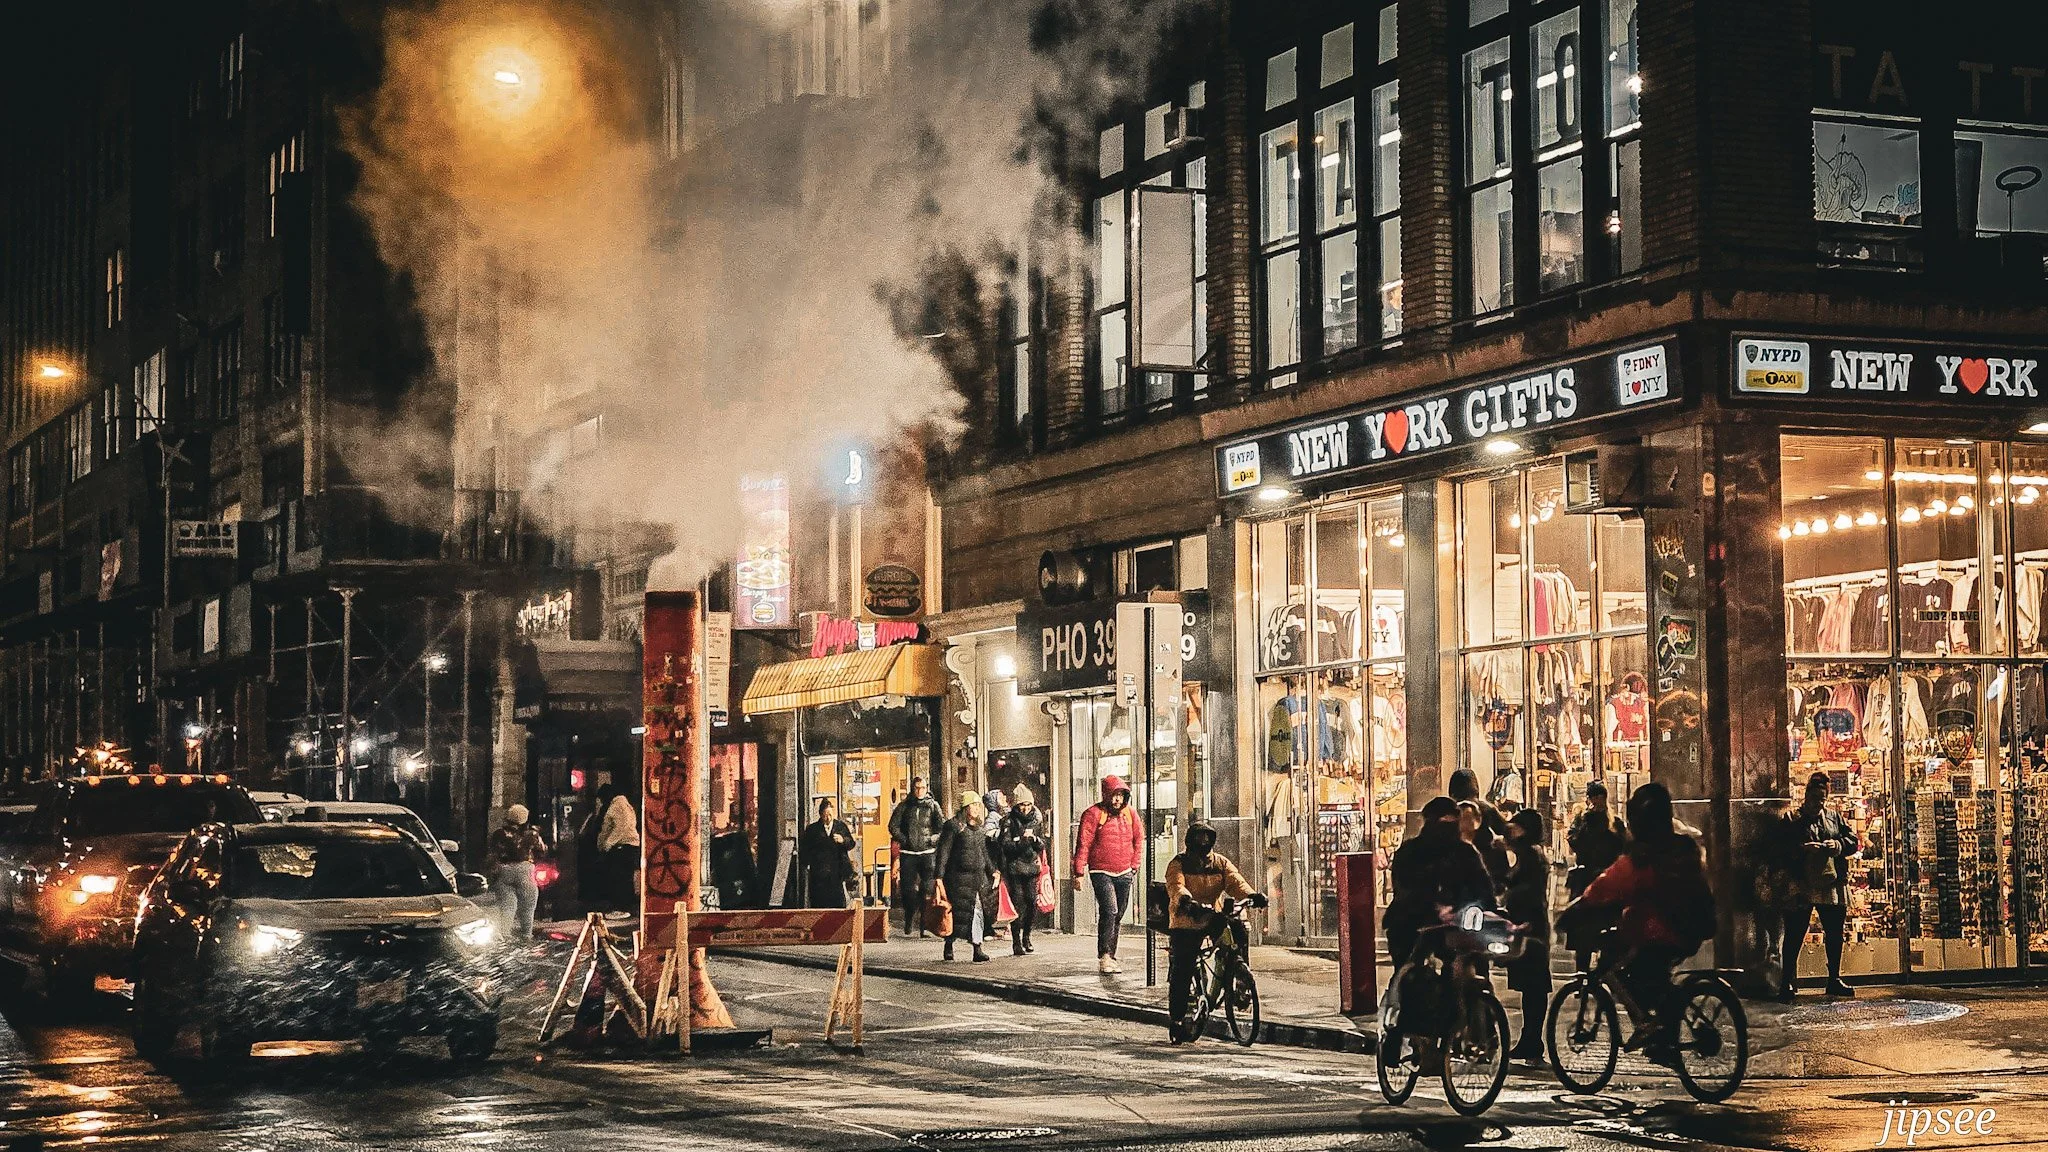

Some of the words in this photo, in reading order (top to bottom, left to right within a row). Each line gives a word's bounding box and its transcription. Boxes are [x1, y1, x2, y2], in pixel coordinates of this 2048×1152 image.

[1632, 353, 1660, 372] FDNY
[1760, 348, 1802, 363] NYPD
[1765, 371, 1796, 385] TAXI
[1830, 349, 1914, 392] NEW
[1288, 421, 1350, 477] NEW
[1465, 367, 1579, 438] GIFTS
[1236, 450, 1255, 464] NYPD
[1042, 621, 1087, 673] PHO
[1093, 617, 1117, 667] 39
